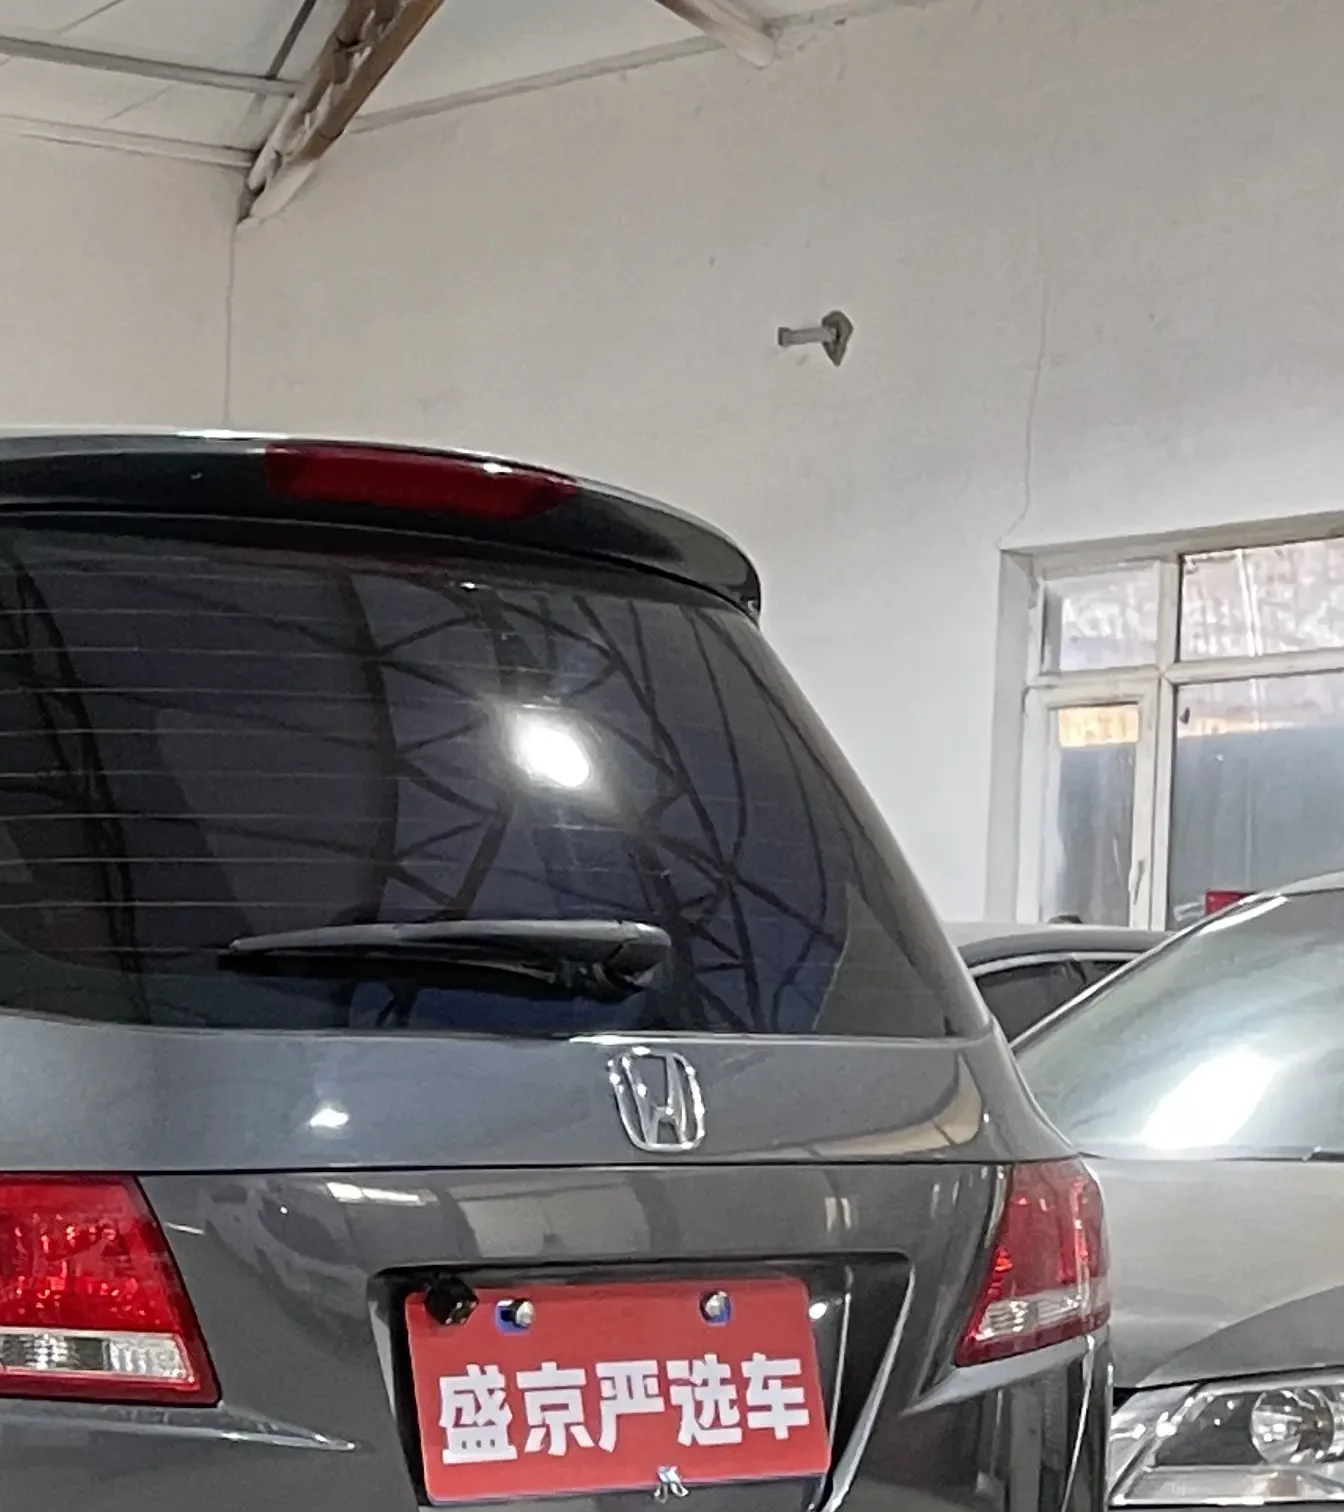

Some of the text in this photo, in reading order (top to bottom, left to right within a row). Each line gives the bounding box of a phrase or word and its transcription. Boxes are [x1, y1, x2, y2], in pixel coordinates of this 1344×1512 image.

[438, 1352, 810, 1465] 盛京严选车
